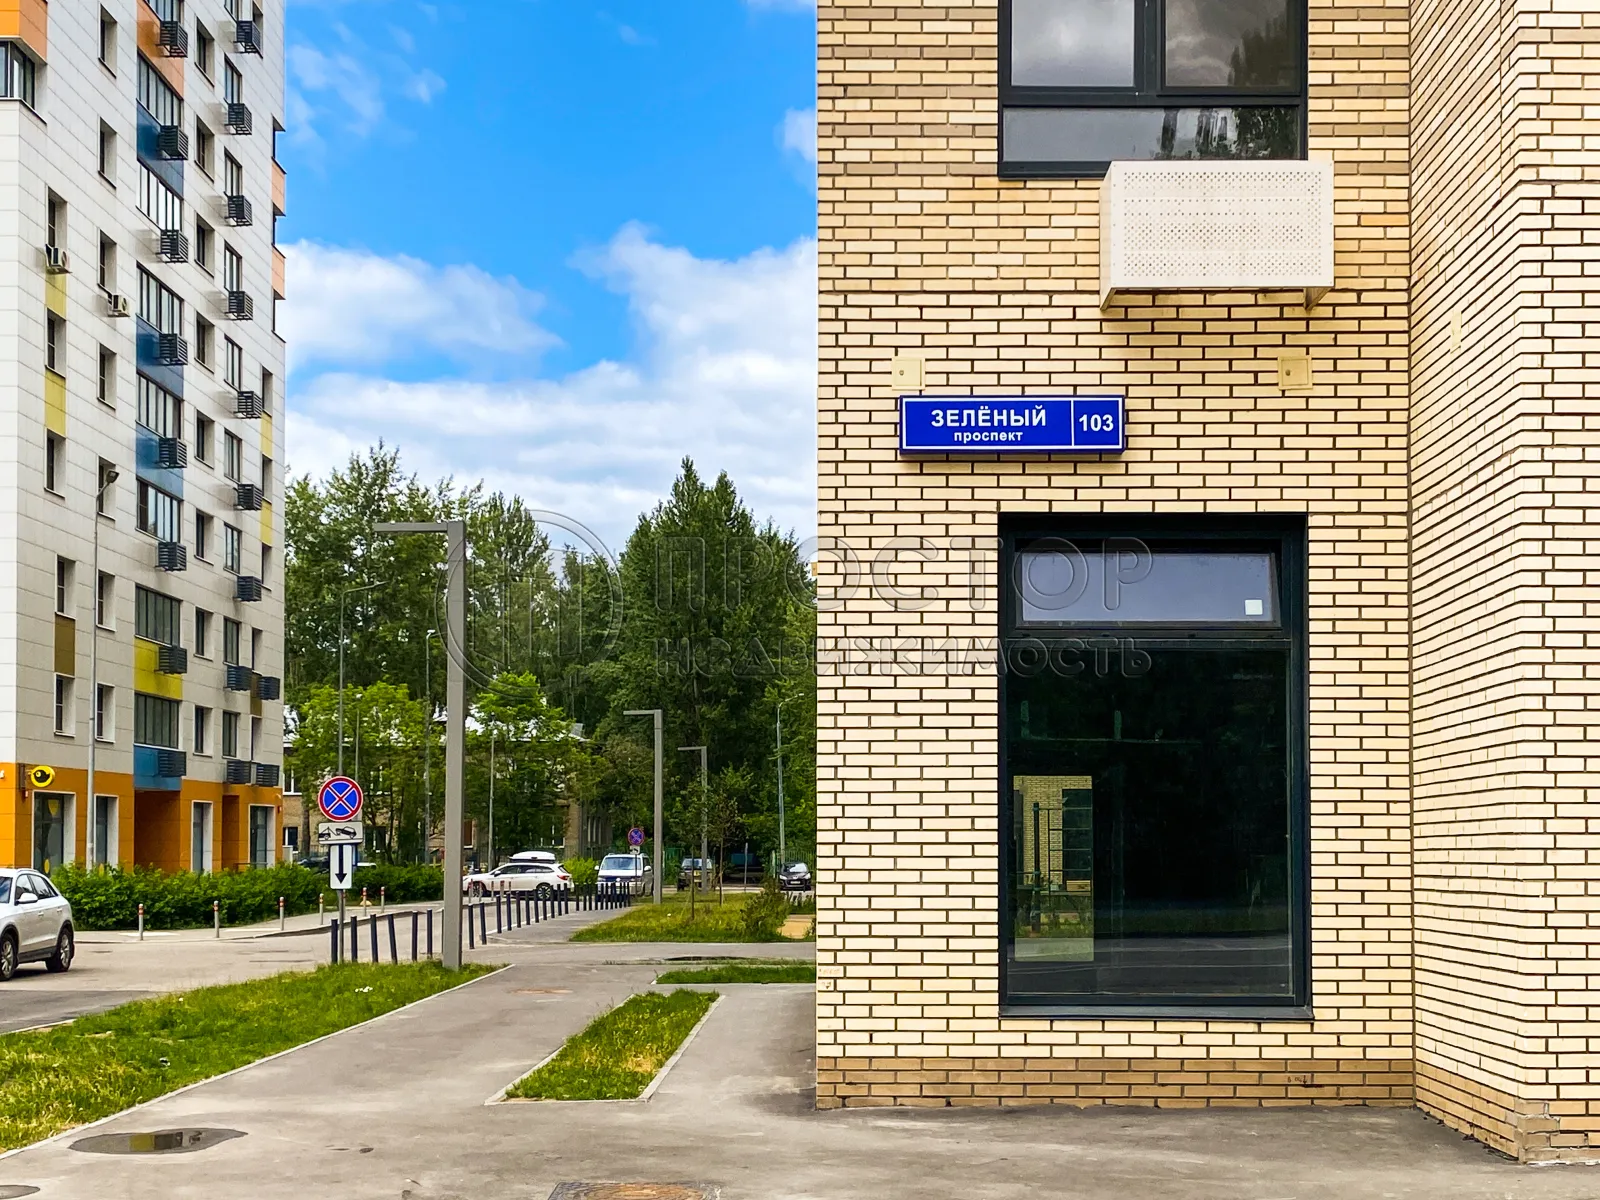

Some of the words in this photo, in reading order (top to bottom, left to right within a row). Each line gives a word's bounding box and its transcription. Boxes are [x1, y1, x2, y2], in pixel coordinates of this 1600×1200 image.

[931, 405, 1047, 427] ЗЕЛЁНЫЙ
[1078, 414, 1114, 432] 103
[953, 431, 1024, 444] проспект
